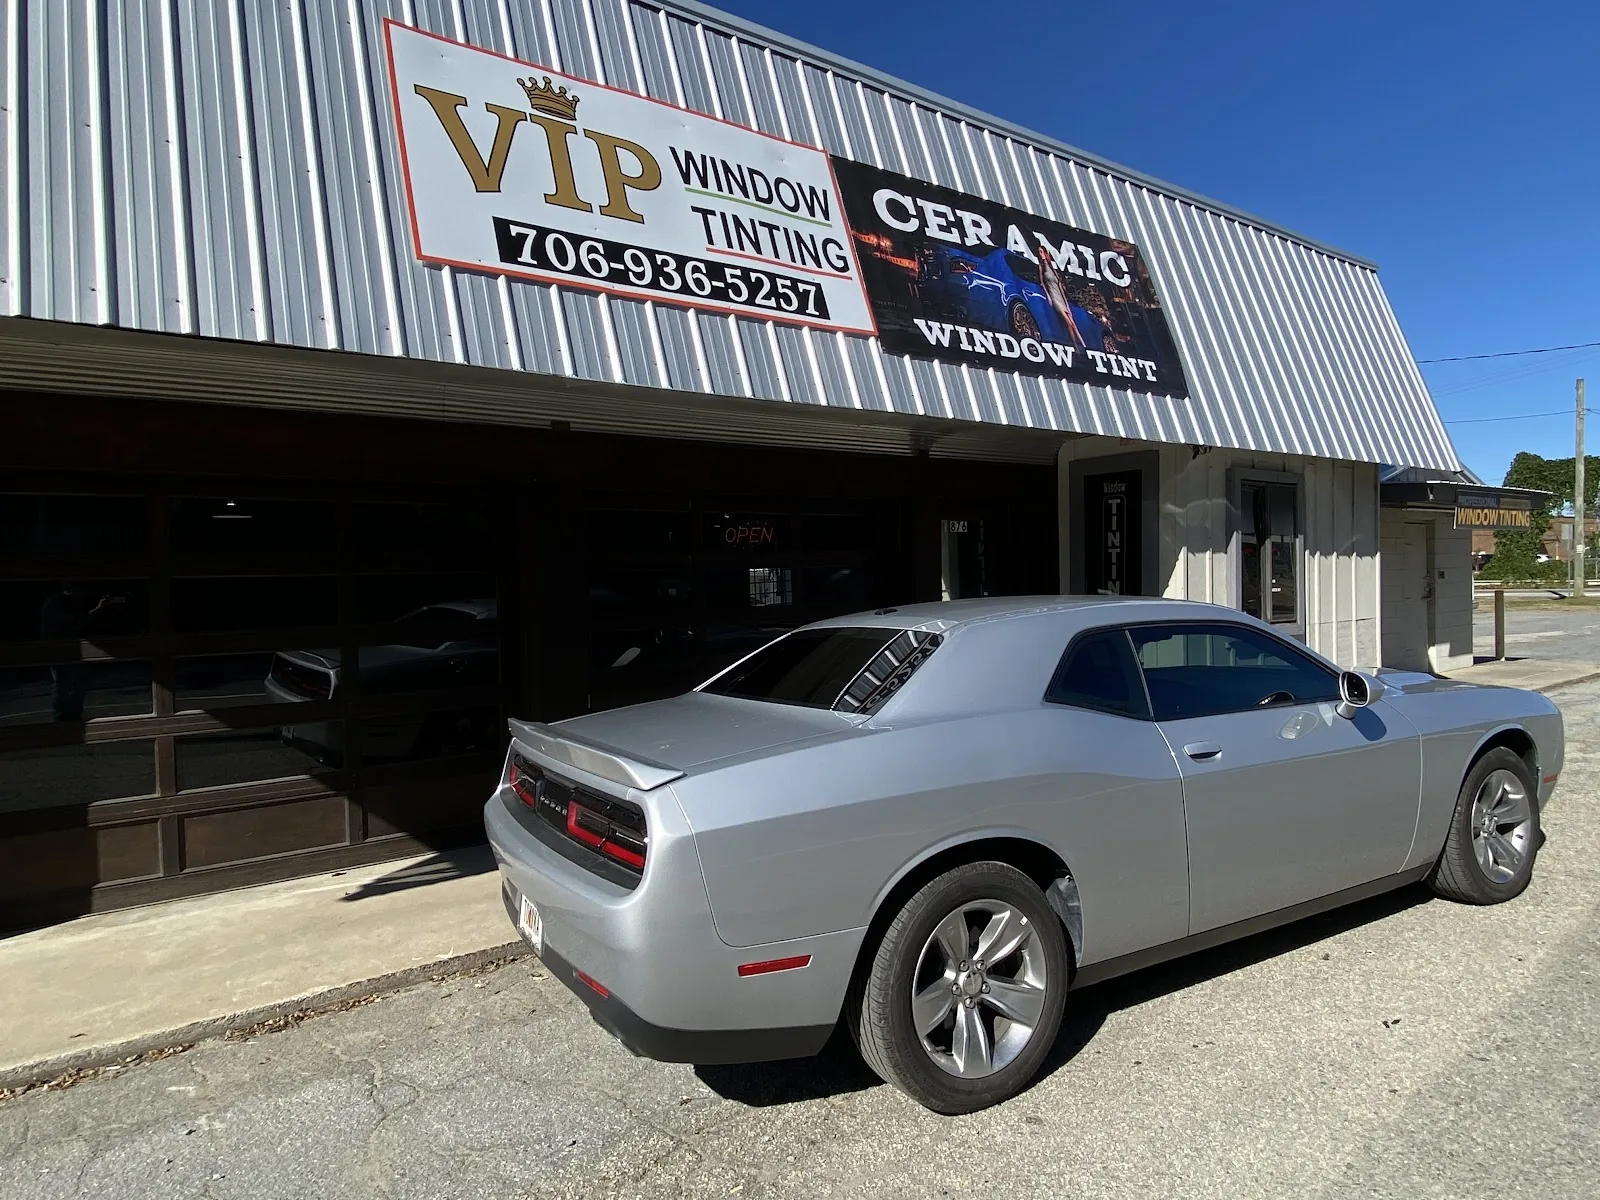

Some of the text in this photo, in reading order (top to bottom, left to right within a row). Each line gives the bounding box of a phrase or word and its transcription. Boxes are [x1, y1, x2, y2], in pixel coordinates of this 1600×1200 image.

[414, 84, 662, 224] VIP
[669, 147, 831, 221] WINDOW
[509, 224, 820, 316] 706-936-5257
[691, 206, 849, 273] TINTING
[872, 188, 1131, 287] CERAMIC
[913, 318, 1157, 382] WINDOW TINT
[725, 526, 774, 544] OPEN
[950, 521, 967, 532] 876
[1458, 508, 1530, 527] WINDOW TINTING
